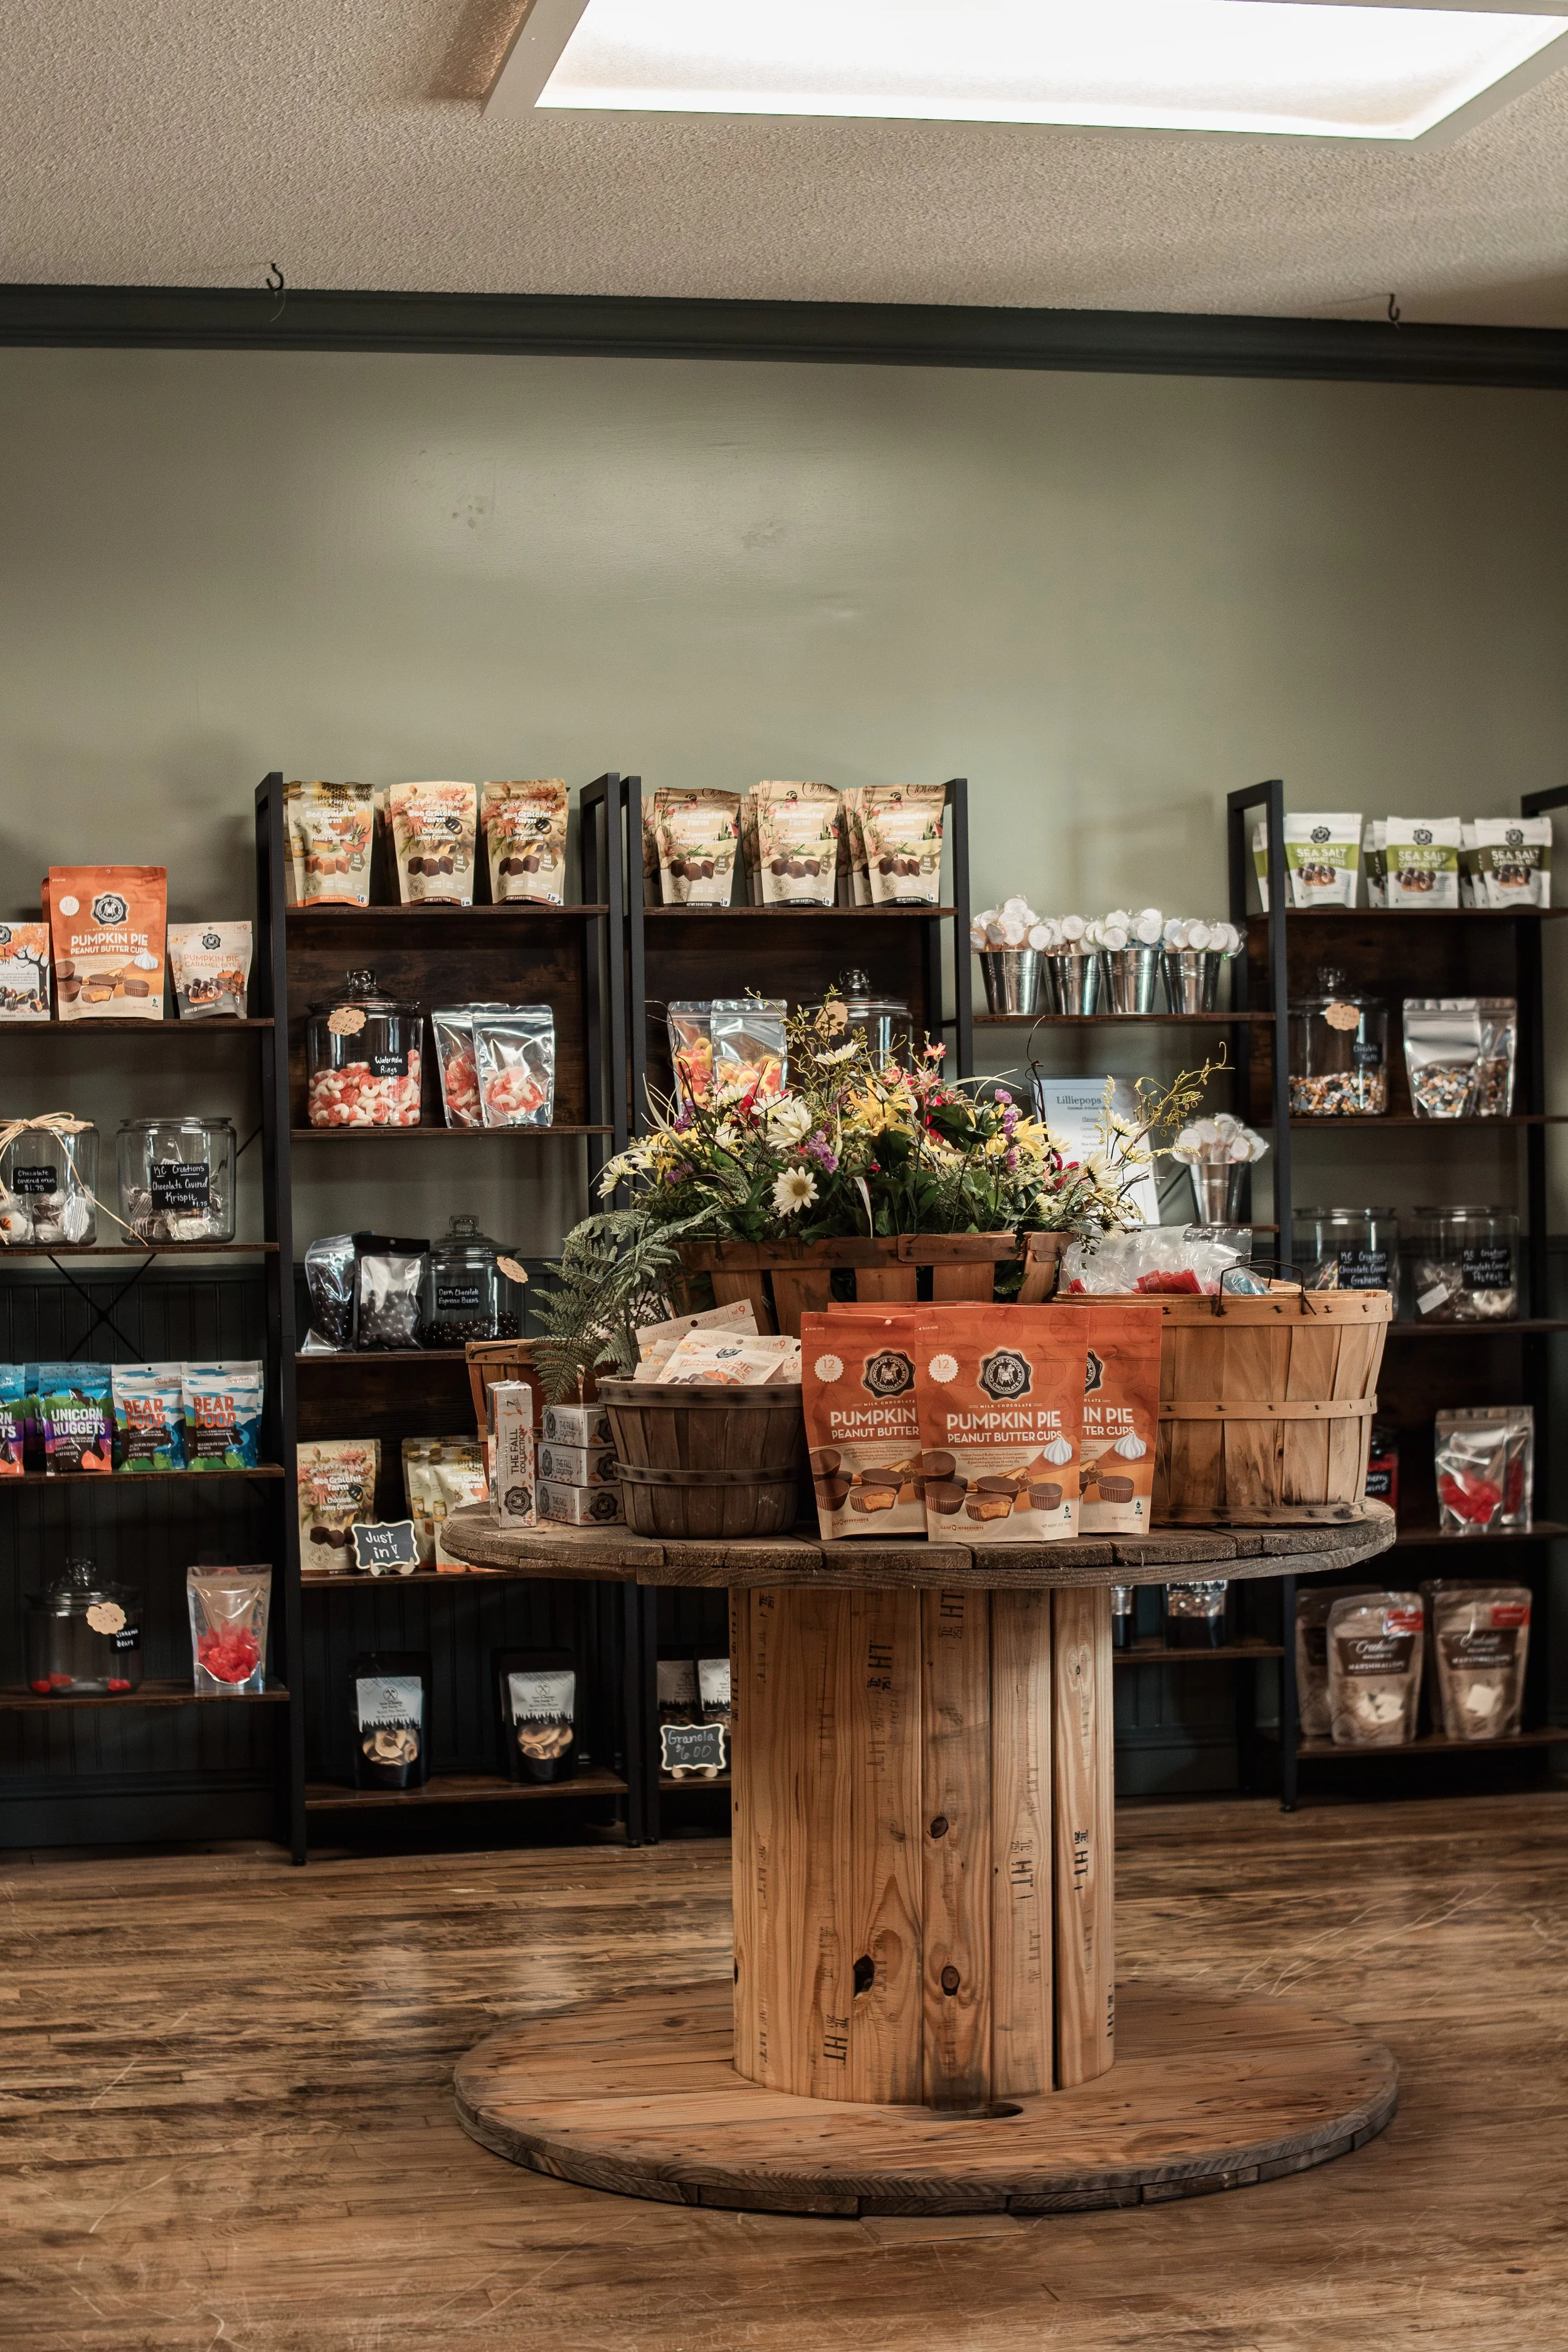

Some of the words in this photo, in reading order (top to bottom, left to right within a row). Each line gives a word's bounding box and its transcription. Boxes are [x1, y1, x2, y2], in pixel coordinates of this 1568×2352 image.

[1296, 848, 1319, 857] SEA
[1322, 848, 1347, 857] SALT
[1399, 850, 1419, 862] SEA
[1491, 850, 1511, 861] SEA
[71, 933, 126, 946] PUMPKIN
[130, 934, 148, 946] PIE
[71, 946, 99, 955] PEANUT
[184, 954, 223, 962] PUMPKIN
[375, 1056, 402, 1064] Watermelon
[380, 1065, 397, 1075] Rings
[1056, 1096, 1102, 1106] Lilliepops
[154, 1166, 167, 1175] KC
[172, 1165, 204, 1173] Creations
[152, 1179, 182, 1190] Chocolate
[185, 1177, 208, 1189] Covered
[165, 1192, 197, 1204] Krispie
[1339, 1264, 1369, 1274] Chocolate
[1463, 1262, 1491, 1272] Chocolate
[438, 1297, 460, 1305] Espresso
[739, 1305, 746, 1315] 9
[780, 1340, 785, 1348] 9
[734, 1360, 753, 1374] PIE
[792, 1362, 798, 1370] 9
[823, 1359, 835, 1369] 12
[937, 1359, 949, 1369] 12
[720, 1364, 747, 1380] BITES
[876, 1379, 903, 1389] CHOCOLATE
[992, 1380, 1020, 1391] CHOCOLATE
[123, 1398, 163, 1414] BEAR
[193, 1396, 234, 1412] BEAR
[51, 1407, 103, 1422] UNICORN
[195, 1412, 236, 1428] POOP
[830, 1407, 916, 1426] PUMPKIN
[946, 1411, 1032, 1430] PUMPKIN
[1037, 1411, 1062, 1428] PIE
[1106, 1407, 1134, 1423] PIE
[126, 1413, 166, 1430] POOP
[53, 1421, 105, 1436] NUGGETS
[832, 1428, 875, 1439] PEANUT
[877, 1426, 919, 1438] BUTTER
[1108, 1426, 1135, 1436] CUPS
[509, 1429, 518, 1451] FALL
[948, 1433, 992, 1443] PEANUT
[995, 1431, 1035, 1442] BUTTER
[1037, 1430, 1062, 1441] CUPS
[518, 1428, 526, 1474] COLLECTION
[511, 1454, 519, 1475] THE
[329, 1475, 362, 1484] Grateful
[1367, 1475, 1387, 1487] herry
[365, 1531, 395, 1544] Just
[668, 1730, 716, 1745] Granola
